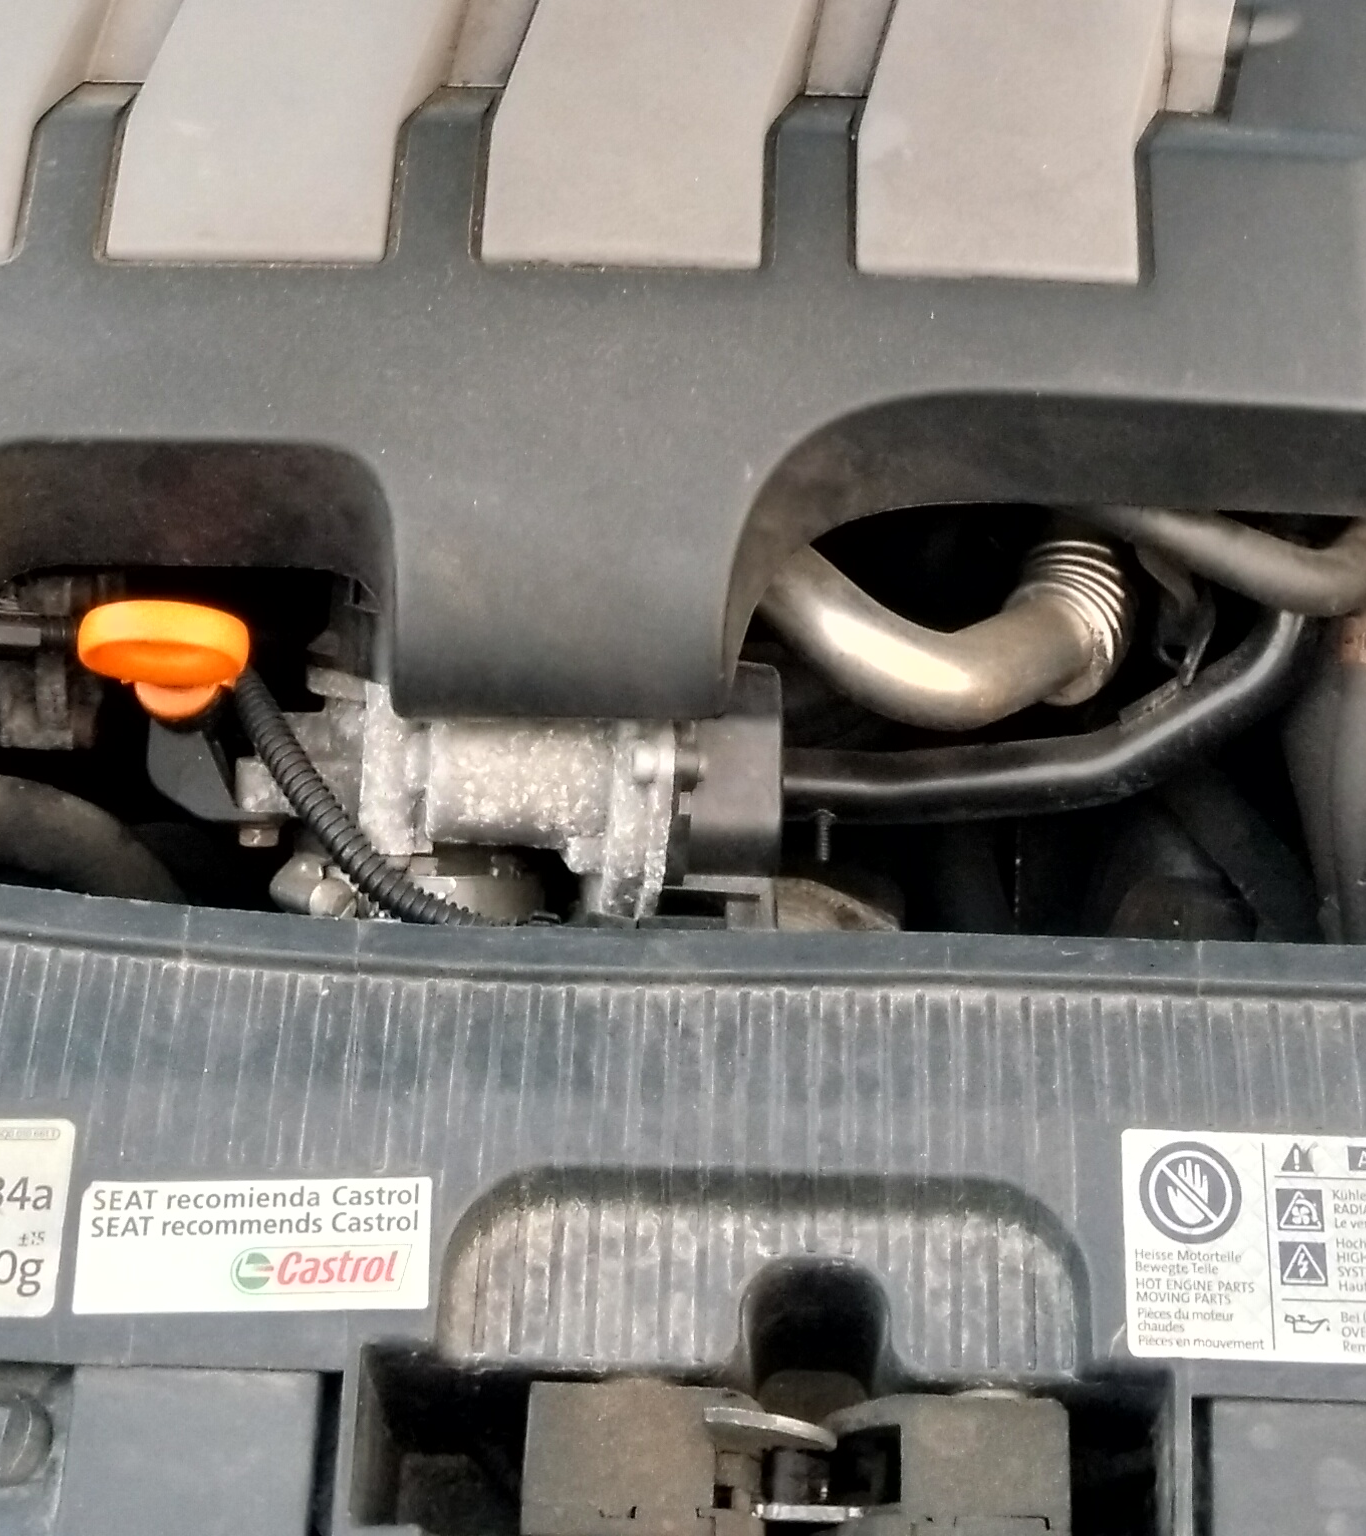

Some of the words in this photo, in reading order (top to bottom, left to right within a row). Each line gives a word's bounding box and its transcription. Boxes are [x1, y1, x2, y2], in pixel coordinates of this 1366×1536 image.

[93, 1189, 159, 1211] SEAT
[166, 1186, 321, 1210] recomienda
[332, 1183, 420, 1206] Castrol
[91, 1216, 154, 1238] SEAT
[161, 1212, 322, 1236] recommends
[331, 1210, 419, 1233] Castrol
[1334, 1217, 1348, 1229] Le
[1135, 1248, 1174, 1261] Heisse
[1177, 1249, 1242, 1263] Motorteile
[276, 1250, 400, 1285] Castrol
[1135, 1260, 1189, 1277] Bewegte
[1191, 1261, 1219, 1275] Teile
[1136, 1277, 1162, 1290] HOT
[1166, 1279, 1214, 1292] ENGINE
[1218, 1280, 1255, 1294] PARTS
[1136, 1291, 1191, 1304] MOVING
[1194, 1292, 1232, 1306] PARTS
[1137, 1307, 1172, 1319] Pièces
[1174, 1307, 1190, 1321] du
[1192, 1309, 1234, 1322] moteur
[1340, 1311, 1361, 1324] Bei
[1137, 1320, 1186, 1333] chaudes
[1138, 1334, 1174, 1347] Pièces
[1176, 1337, 1191, 1347] en
[1193, 1338, 1265, 1351] mouvement
